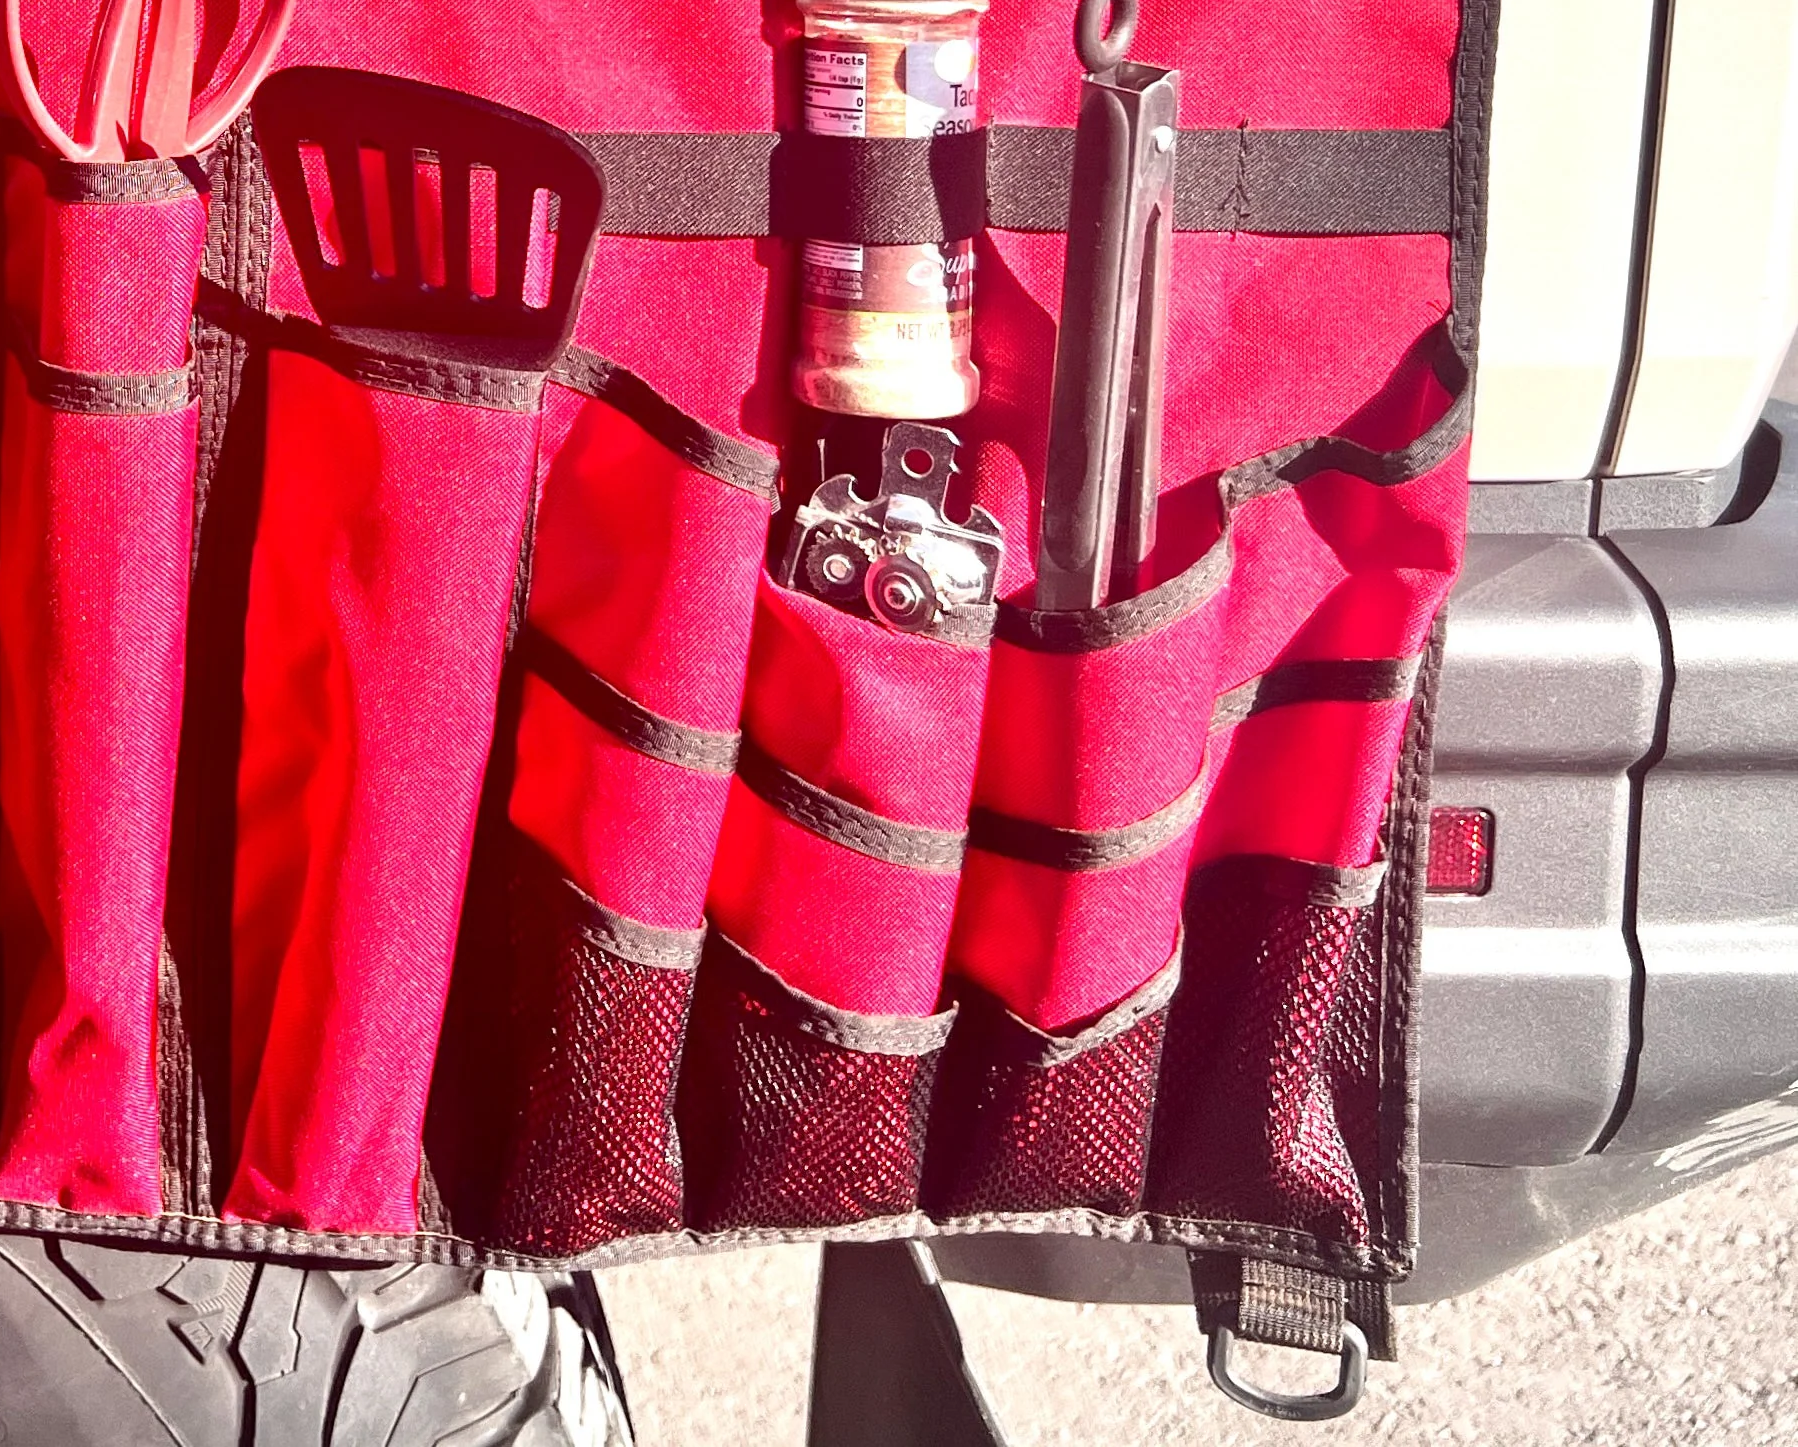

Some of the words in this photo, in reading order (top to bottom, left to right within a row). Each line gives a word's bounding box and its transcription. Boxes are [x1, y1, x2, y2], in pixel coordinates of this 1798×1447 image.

[829, 54, 865, 66] Facts
[856, 97, 864, 107] 0
[896, 323, 922, 340] NET
